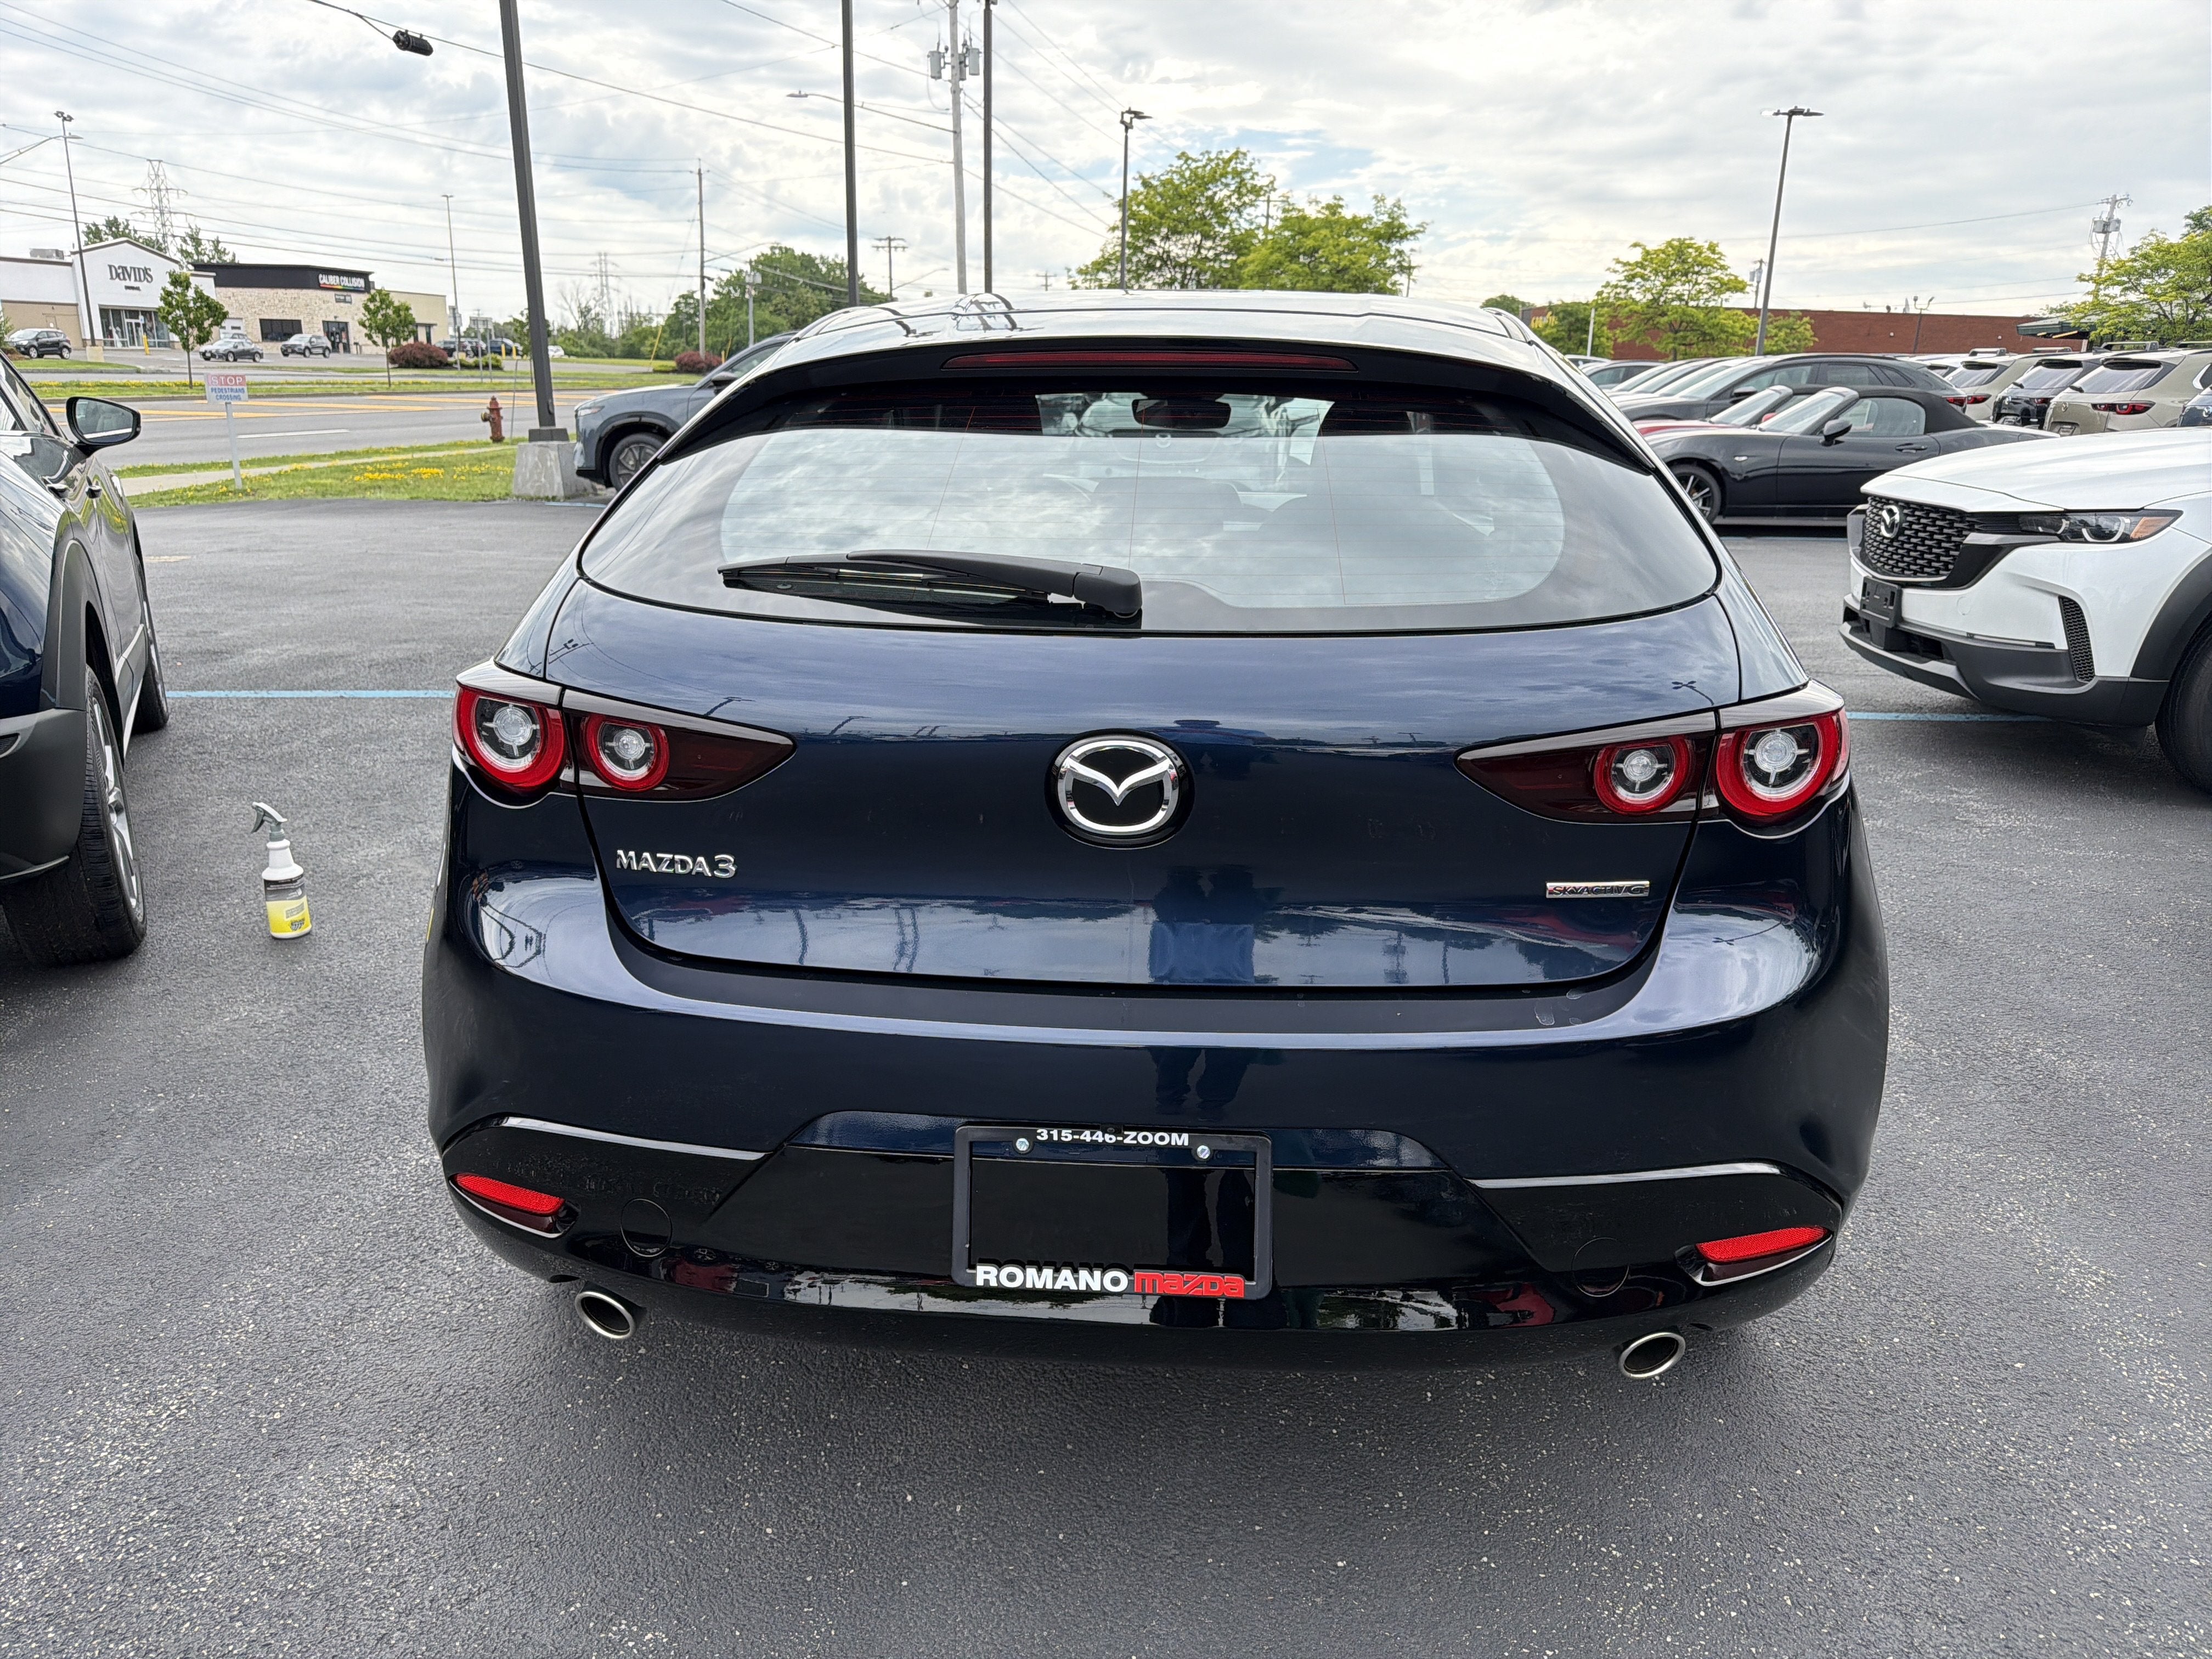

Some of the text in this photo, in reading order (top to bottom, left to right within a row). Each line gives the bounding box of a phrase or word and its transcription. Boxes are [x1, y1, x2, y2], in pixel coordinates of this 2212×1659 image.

[211, 376, 242, 385] STOP
[1036, 1128, 1189, 1146] 315-446-ZOOM
[975, 1265, 1128, 1292] ROMANO
